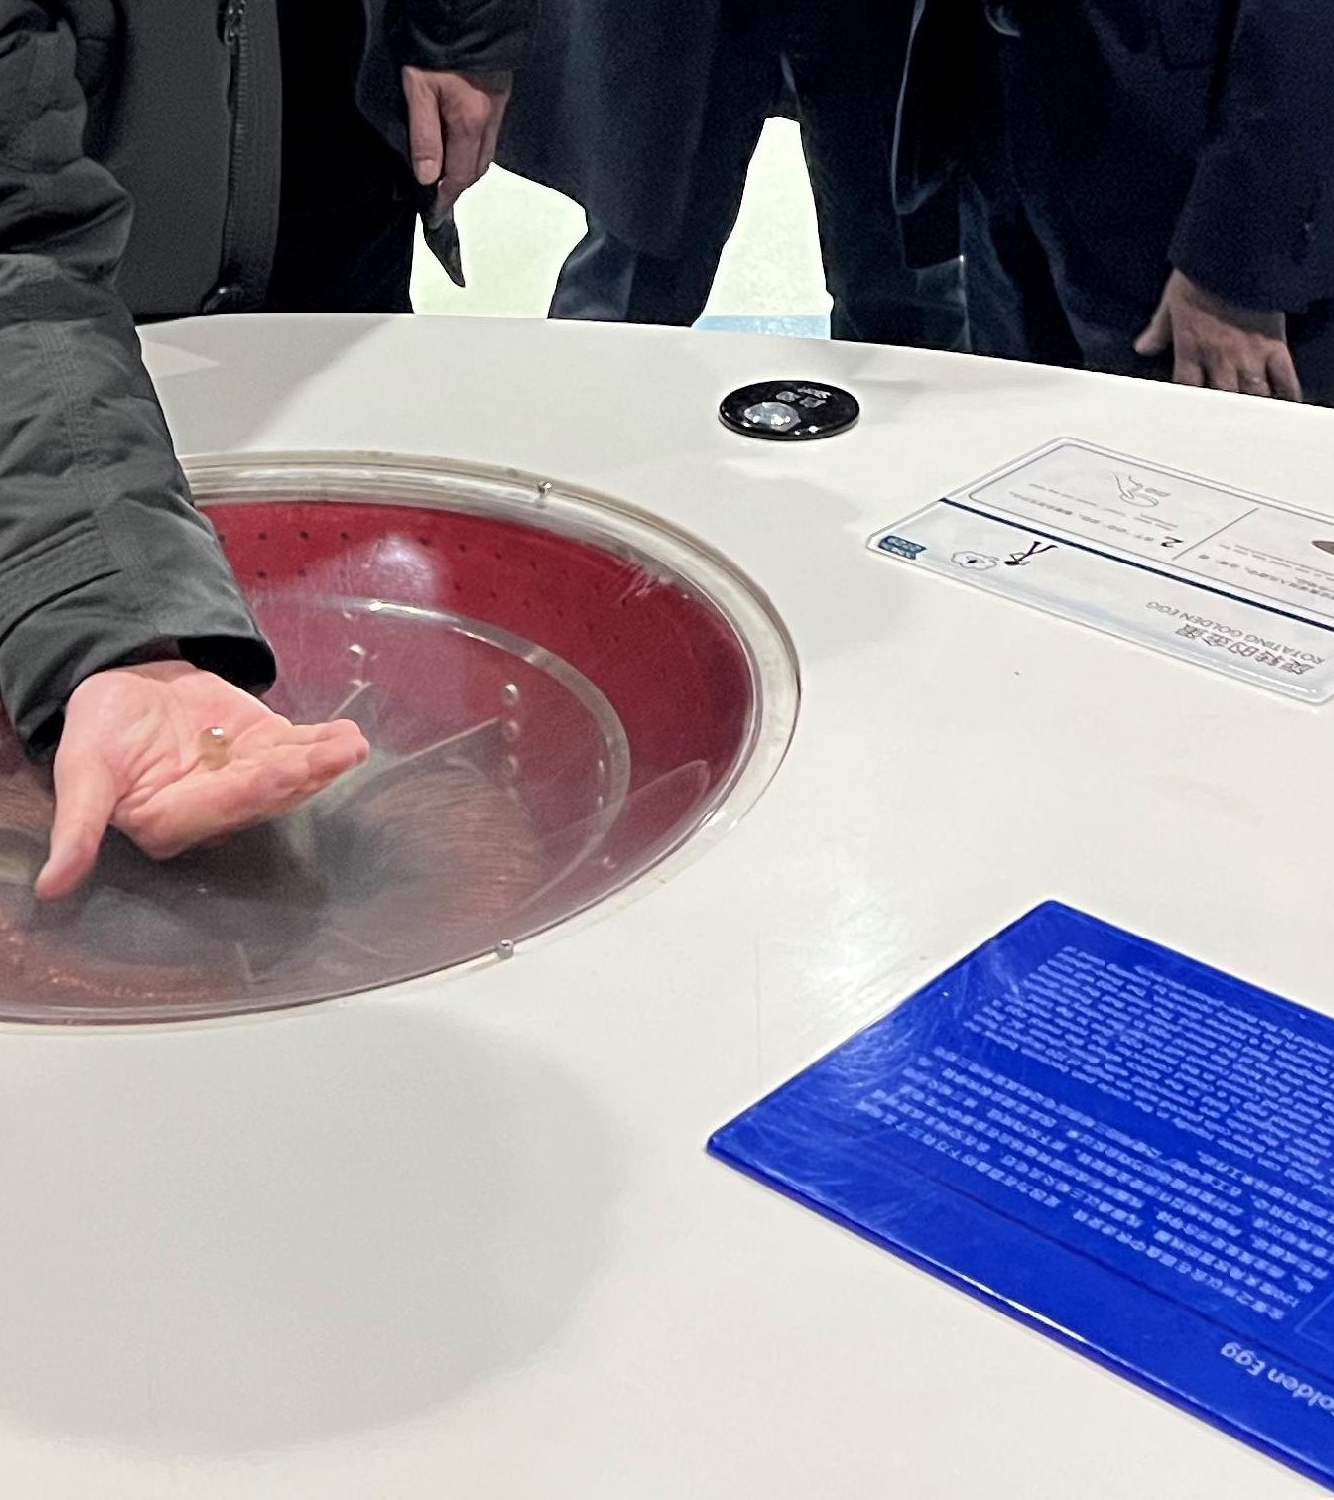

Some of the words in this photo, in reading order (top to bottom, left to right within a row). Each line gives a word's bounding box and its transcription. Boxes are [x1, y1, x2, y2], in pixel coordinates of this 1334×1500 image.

[1176, 611, 1246, 638] GOLDEN
[1241, 633, 1326, 665] ROTATING
[1220, 1340, 1266, 1377] Egg
